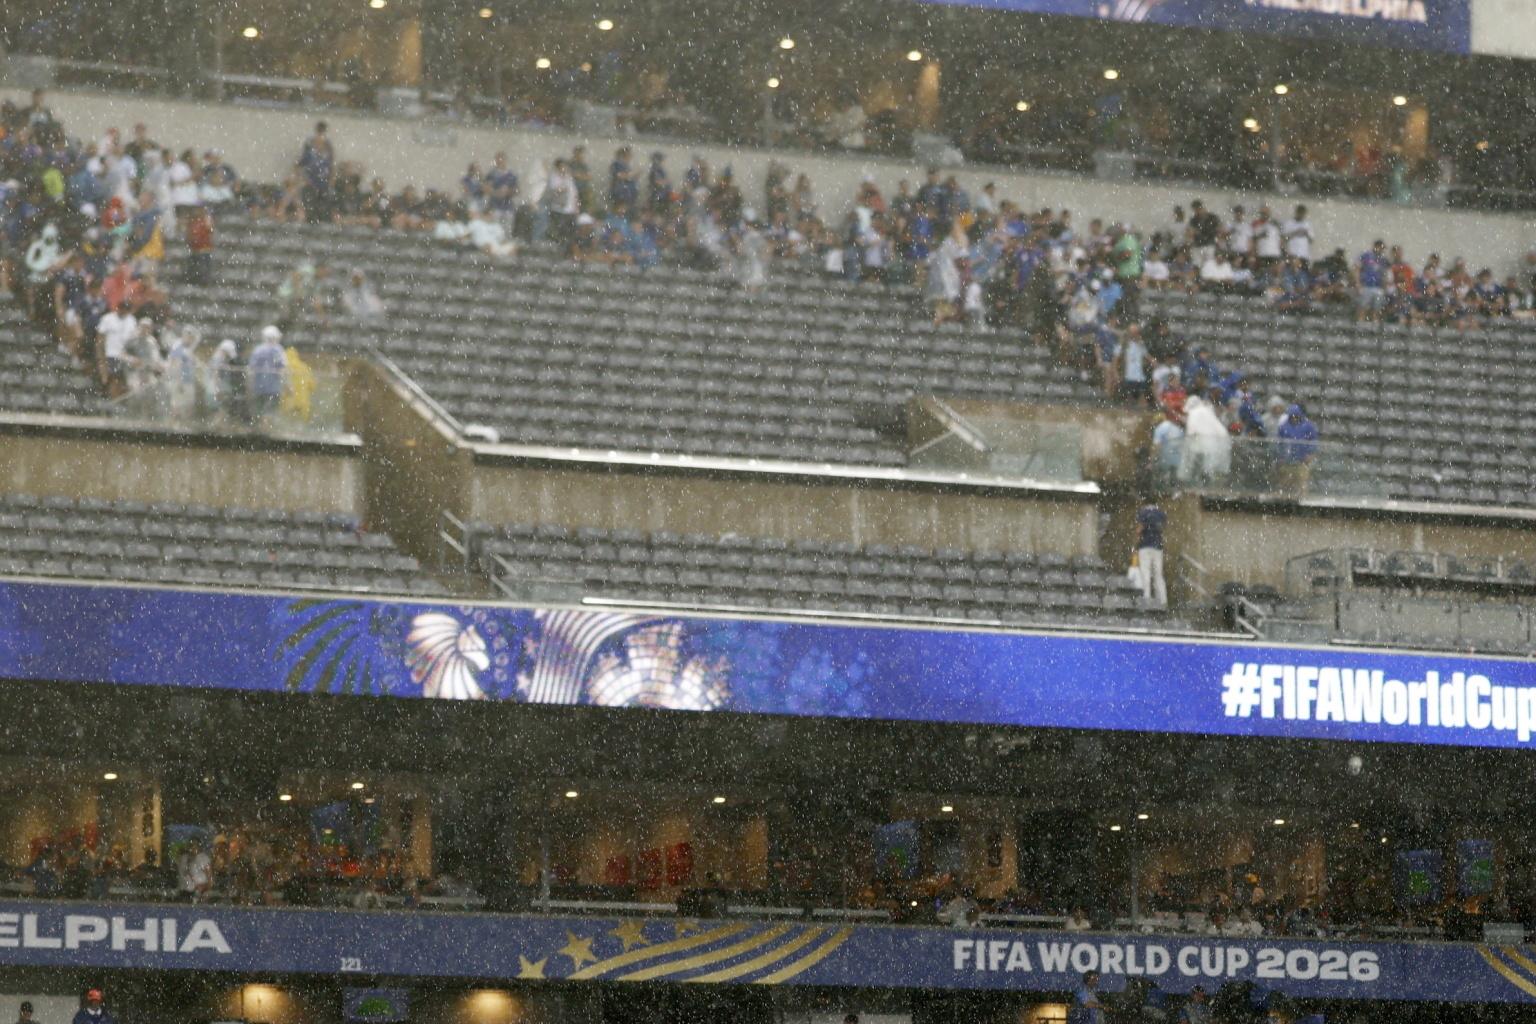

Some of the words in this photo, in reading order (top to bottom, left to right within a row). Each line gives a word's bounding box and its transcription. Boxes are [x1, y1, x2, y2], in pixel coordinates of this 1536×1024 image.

[0, 913, 233, 954] ELPHIA
[953, 939, 1033, 972] FIFA
[1037, 942, 1171, 976] WORLD
[1177, 945, 1250, 977] CUP
[1256, 947, 1381, 982] 2026
